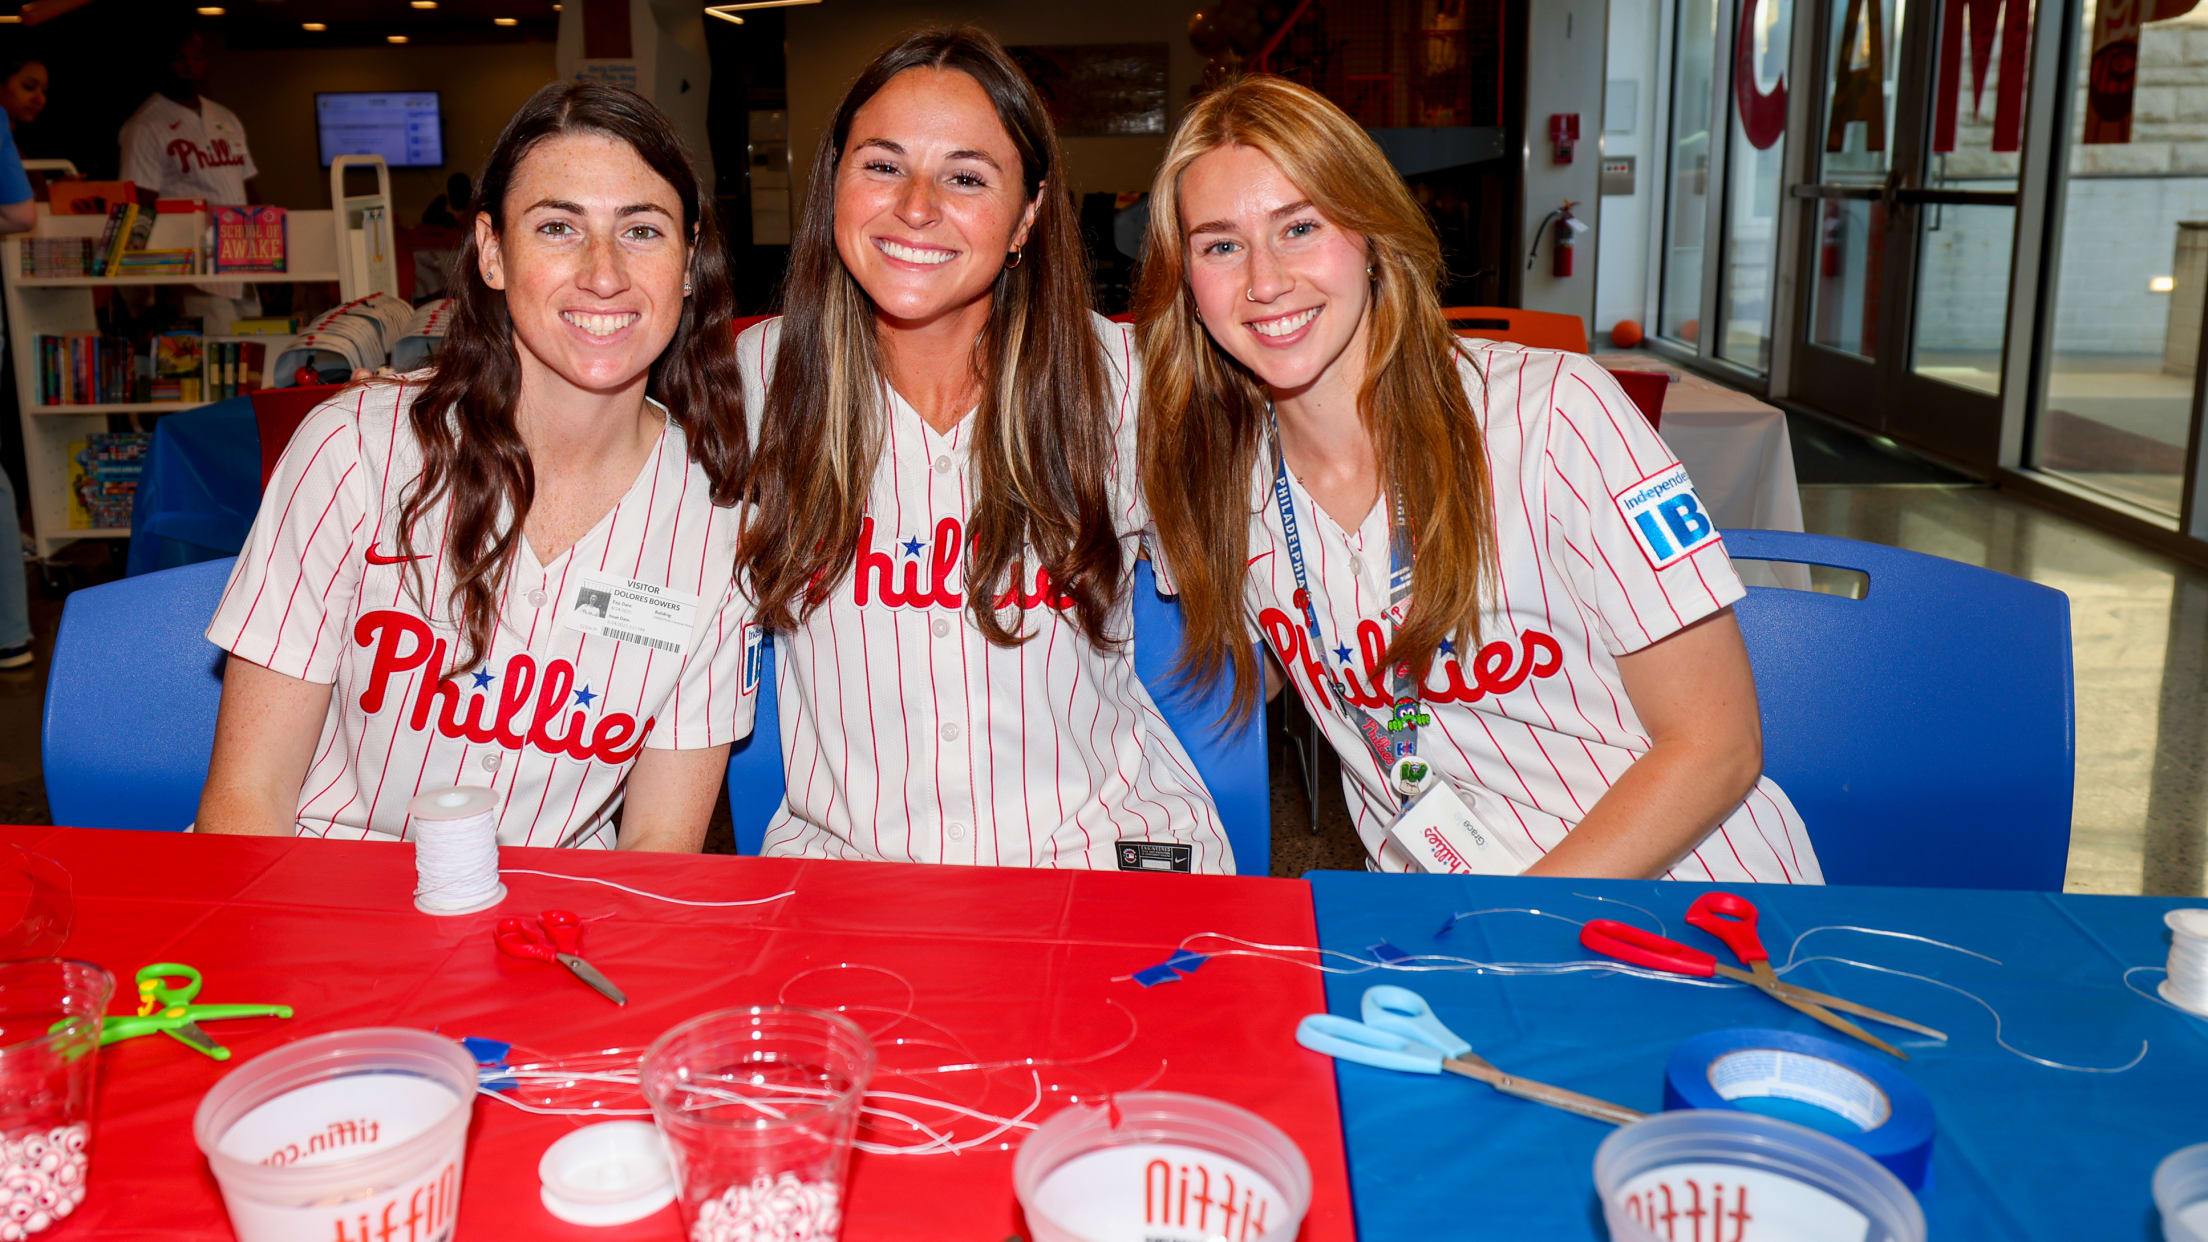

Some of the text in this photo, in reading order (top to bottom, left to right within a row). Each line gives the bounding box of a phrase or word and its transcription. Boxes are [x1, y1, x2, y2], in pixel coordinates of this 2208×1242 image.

[220, 224, 280, 238] SCHOOL OF
[220, 239, 282, 259] AWAKE
[1624, 471, 1690, 510] Independe
[1276, 476, 1306, 590] PHILADELPHIA
[1634, 488, 1717, 561] IB
[614, 589, 648, 604] DOLORES
[649, 598, 681, 612] BOWERS
[627, 580, 660, 594] VISITOR
[354, 609, 656, 765] Phillie
[1361, 716, 1395, 766] Phillies
[1424, 827, 1471, 874] hillies
[1463, 820, 1486, 846] Grace
